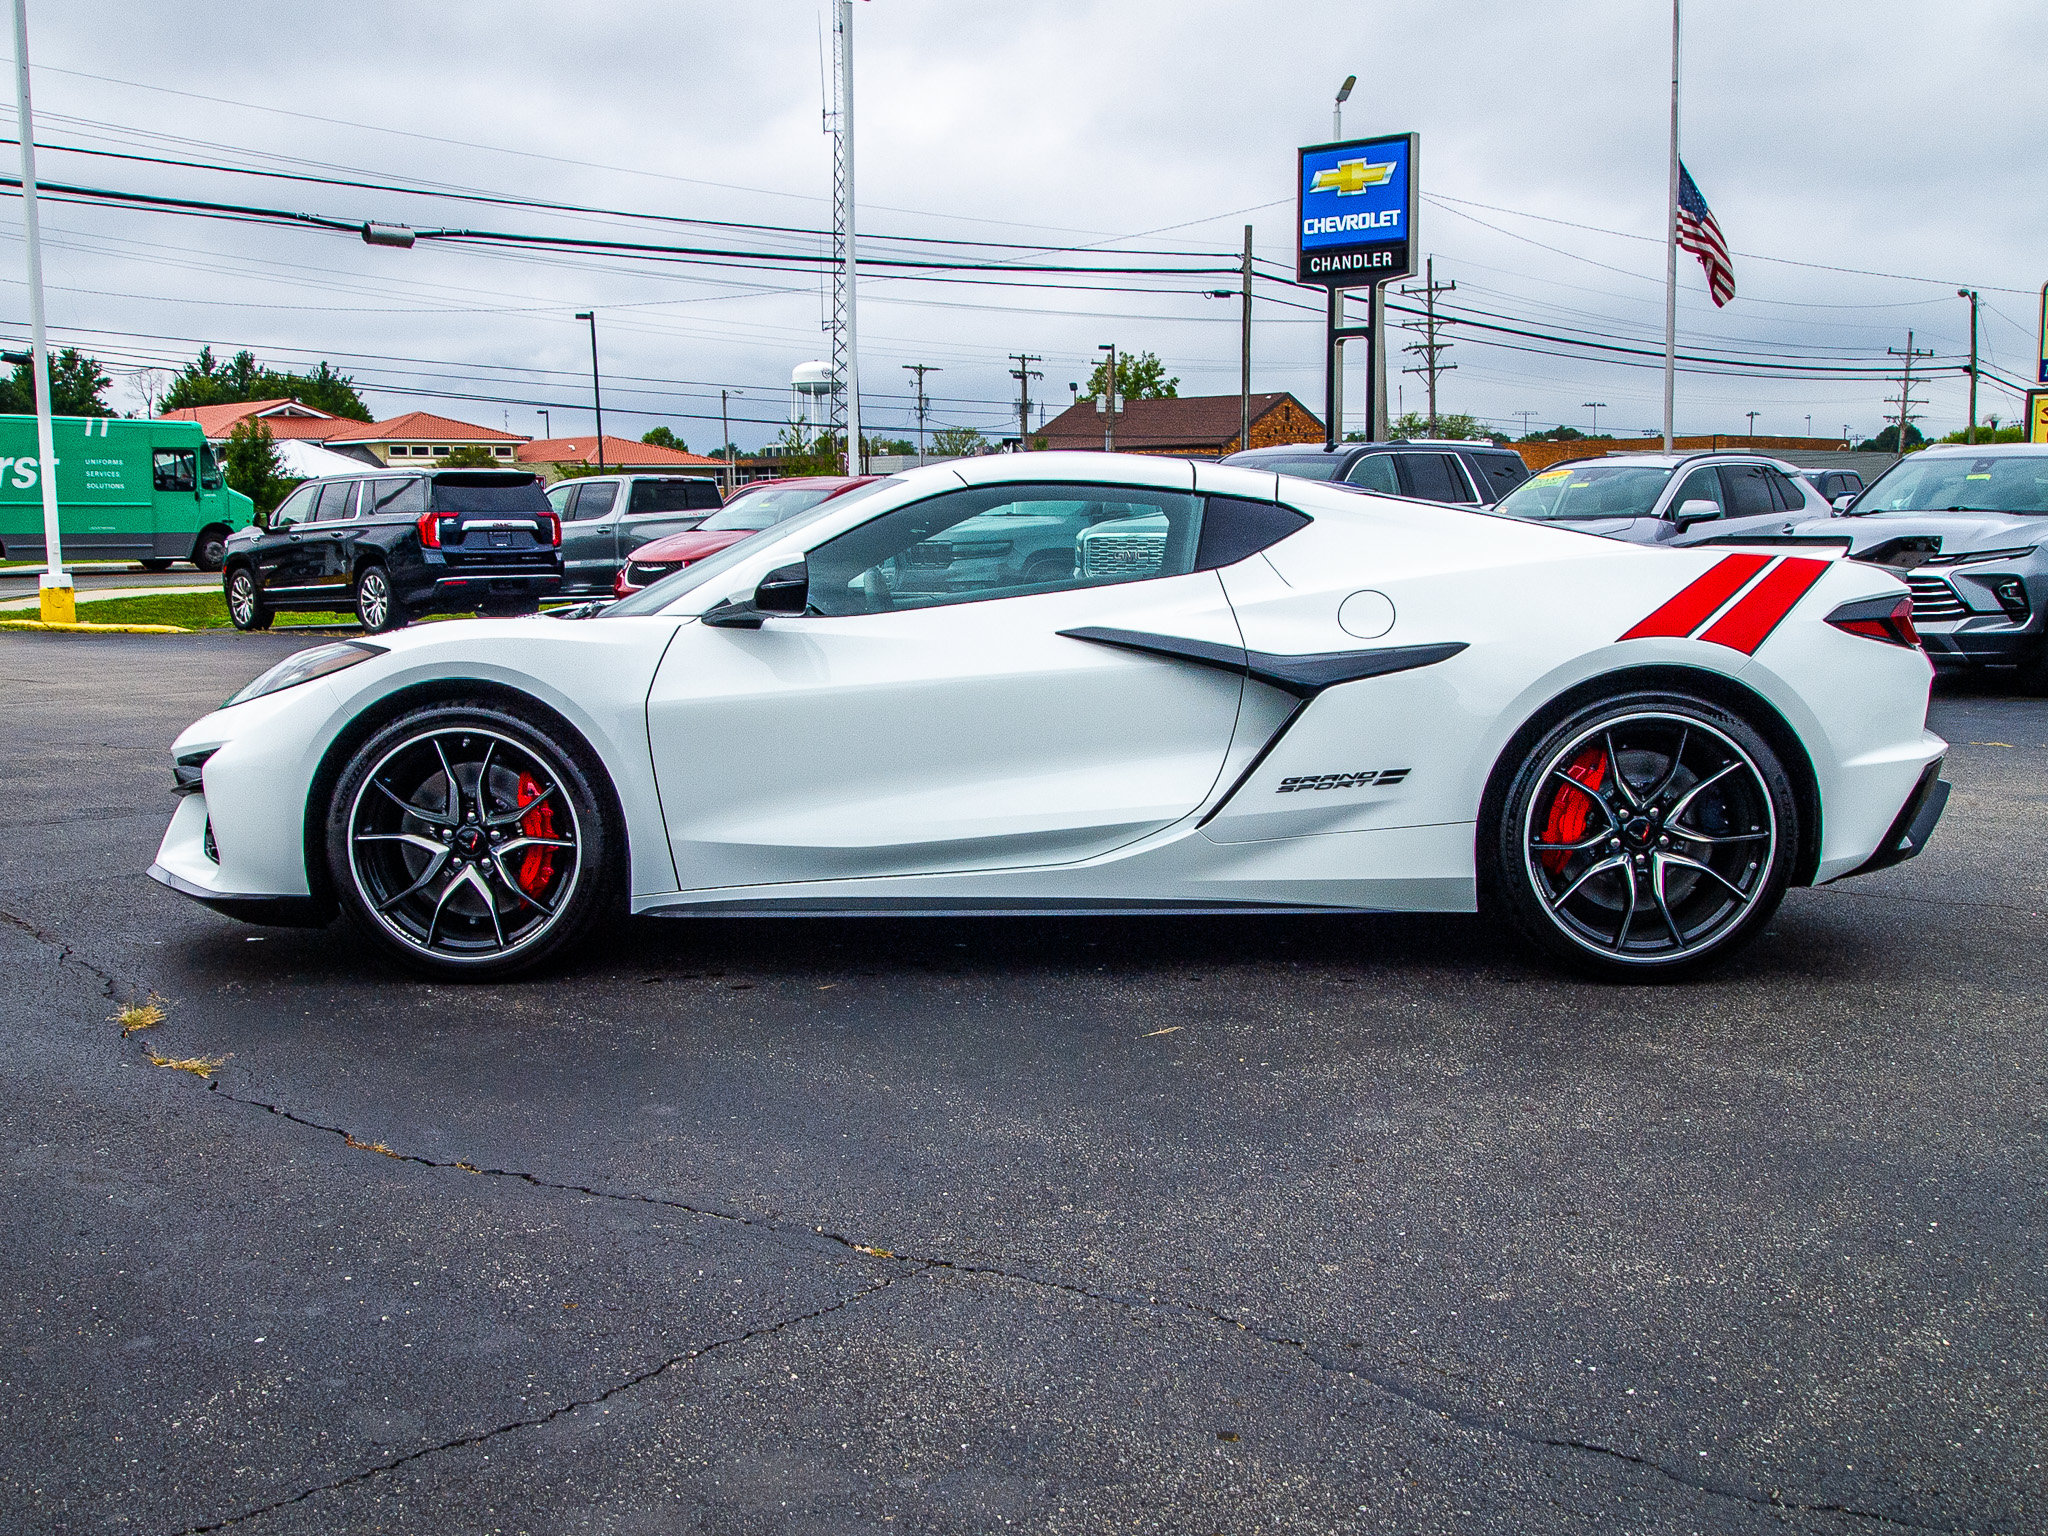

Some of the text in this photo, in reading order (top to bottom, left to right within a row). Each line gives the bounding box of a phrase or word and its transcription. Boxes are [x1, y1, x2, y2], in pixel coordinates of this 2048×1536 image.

[1304, 209, 1401, 235] CHEVROLET
[1311, 252, 1392, 272] CHANDLER
[84, 458, 124, 466] UNIFORMS
[86, 482, 125, 490] SOLUTIONS
[1113, 551, 1149, 561] GMC
[1281, 771, 1378, 785] GRAND
[1275, 779, 1373, 793] SPORT
